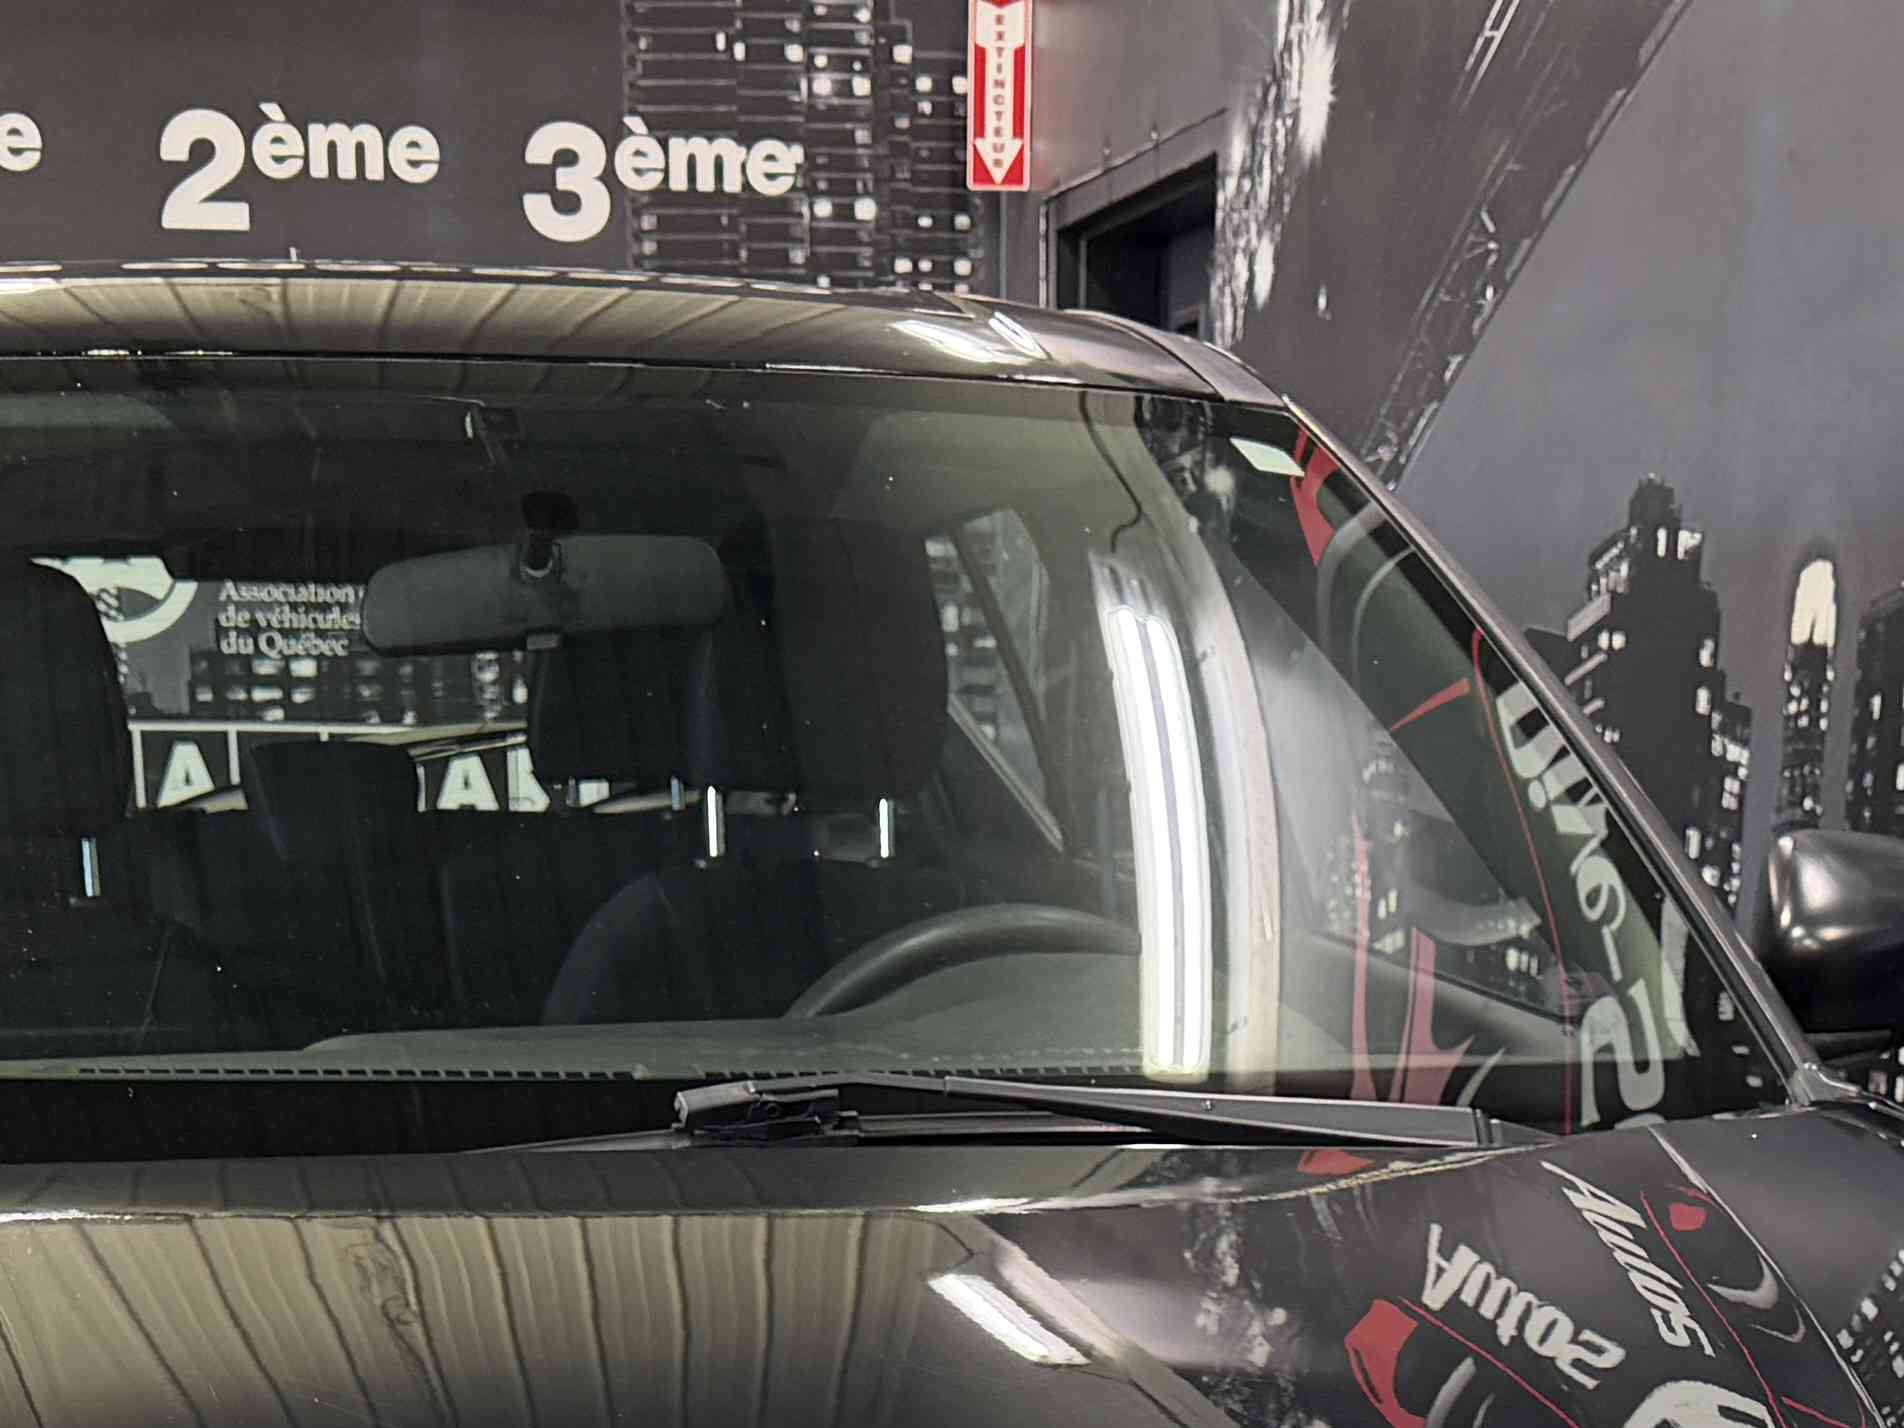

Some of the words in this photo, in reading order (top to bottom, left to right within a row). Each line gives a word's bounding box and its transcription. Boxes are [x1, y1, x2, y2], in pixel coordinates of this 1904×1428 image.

[992, 14, 1006, 169] EXTINCTEUR
[159, 103, 442, 232] 2ème
[522, 117, 806, 243] 3ème
[217, 604, 251, 628] de
[254, 603, 362, 630] véhicules
[218, 578, 356, 603] Association
[219, 630, 255, 655] du
[257, 630, 350, 659] Québec
